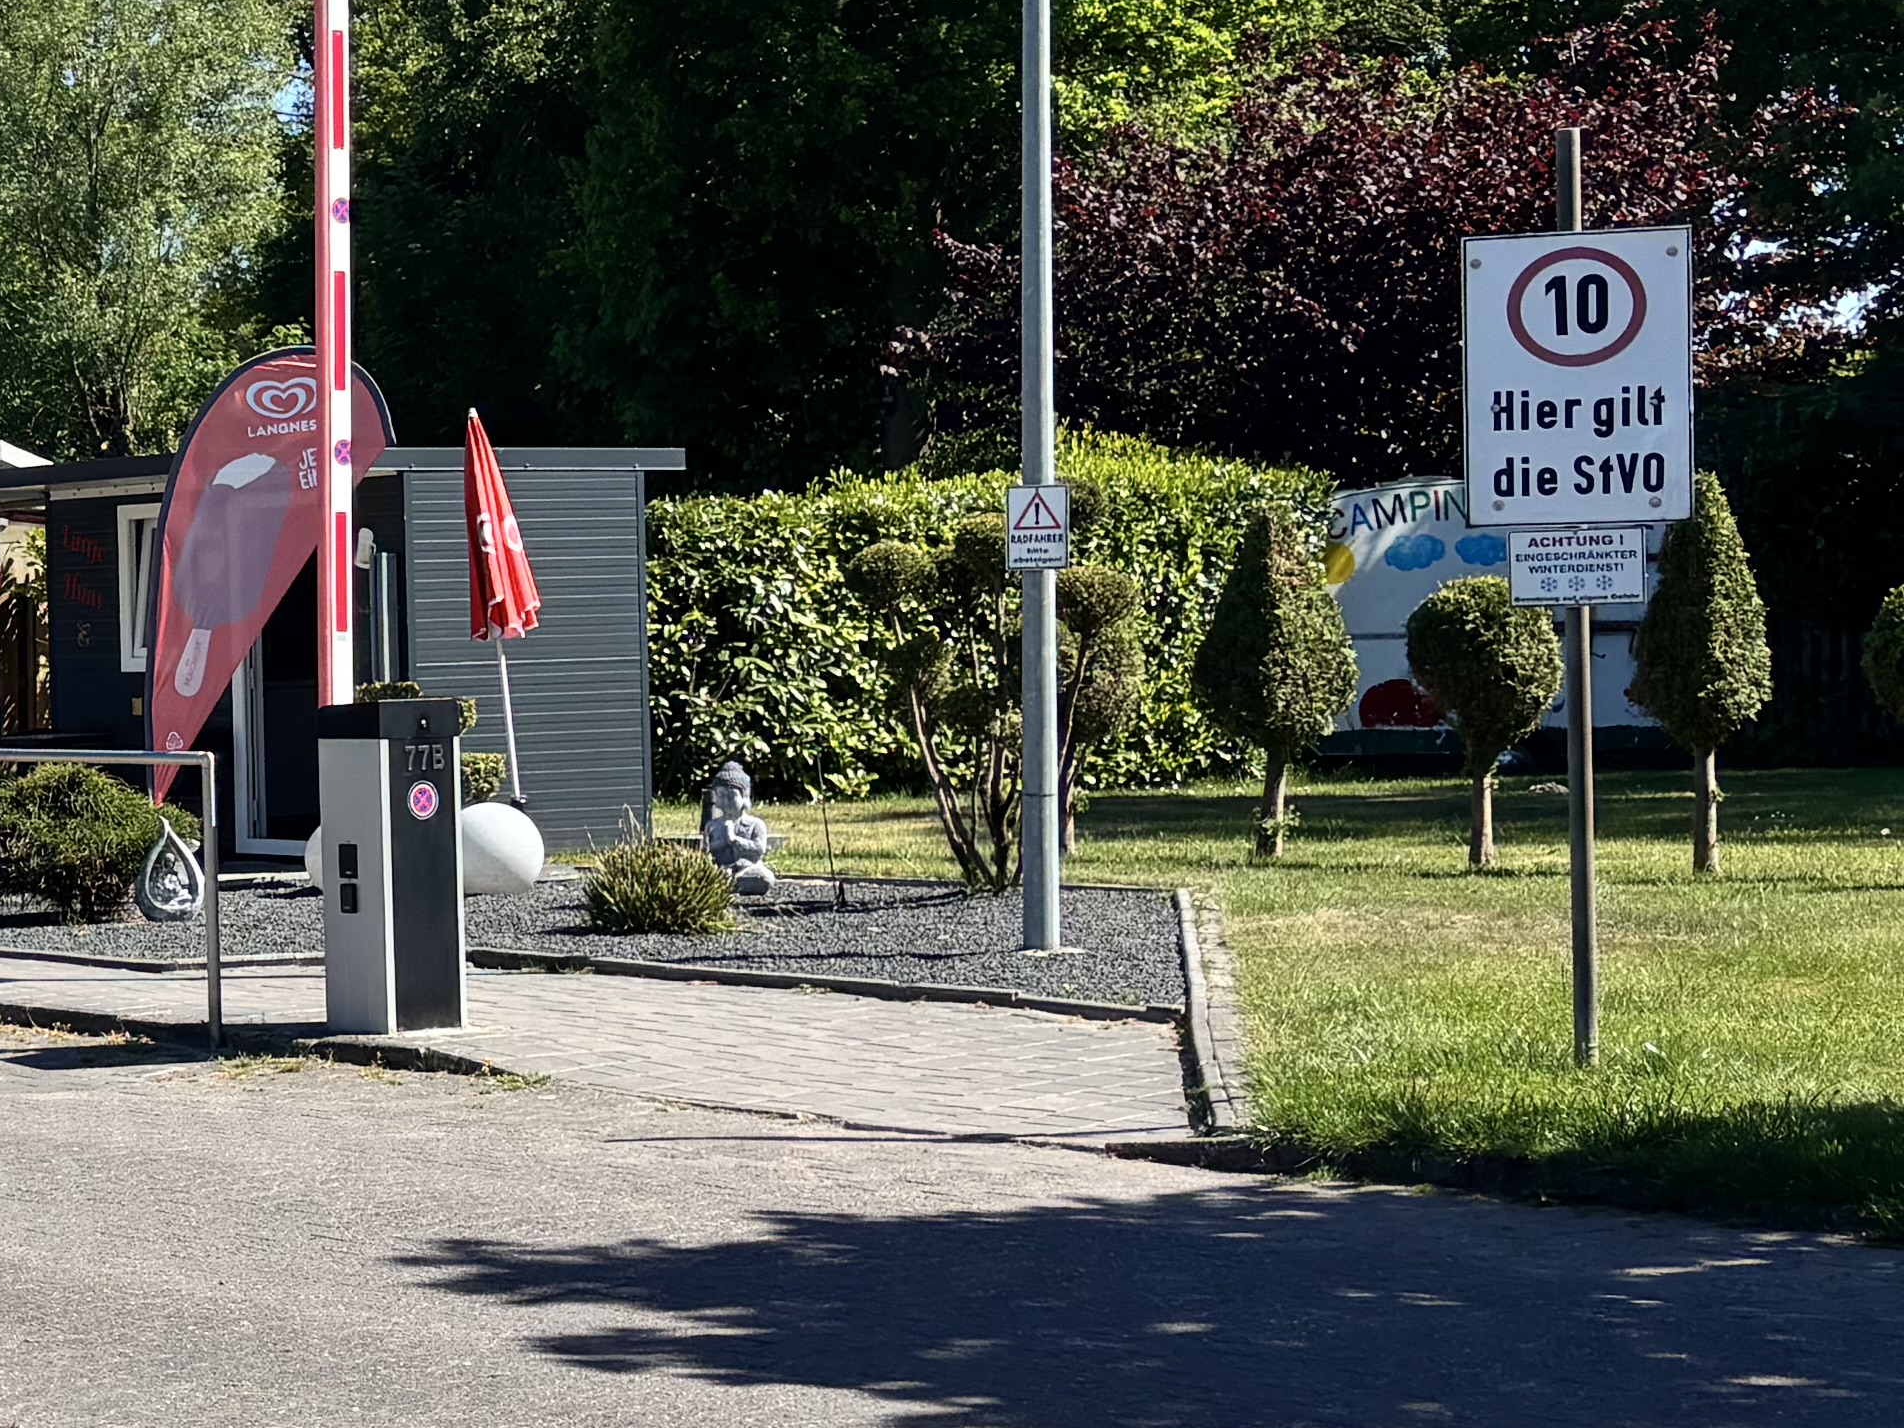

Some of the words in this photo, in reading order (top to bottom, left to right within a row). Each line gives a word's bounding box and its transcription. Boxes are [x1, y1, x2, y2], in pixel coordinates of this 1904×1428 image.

[1545, 274, 1608, 335] 10
[1493, 390, 1582, 432] Hier
[1593, 385, 1665, 438] gilt
[248, 420, 317, 438] LANGNES
[299, 448, 317, 470] JE
[1493, 456, 1558, 497] die
[1573, 452, 1665, 495] StVO
[1329, 486, 1467, 539] CAMPIN
[1011, 533, 1064, 544] RADFAHRER
[1528, 535, 1613, 548] ACHTUNG
[1515, 550, 1638, 563] EINGESCHRÄNKTER
[1528, 563, 1624, 574] WINTERDIENST!
[404, 744, 444, 771] 77B
